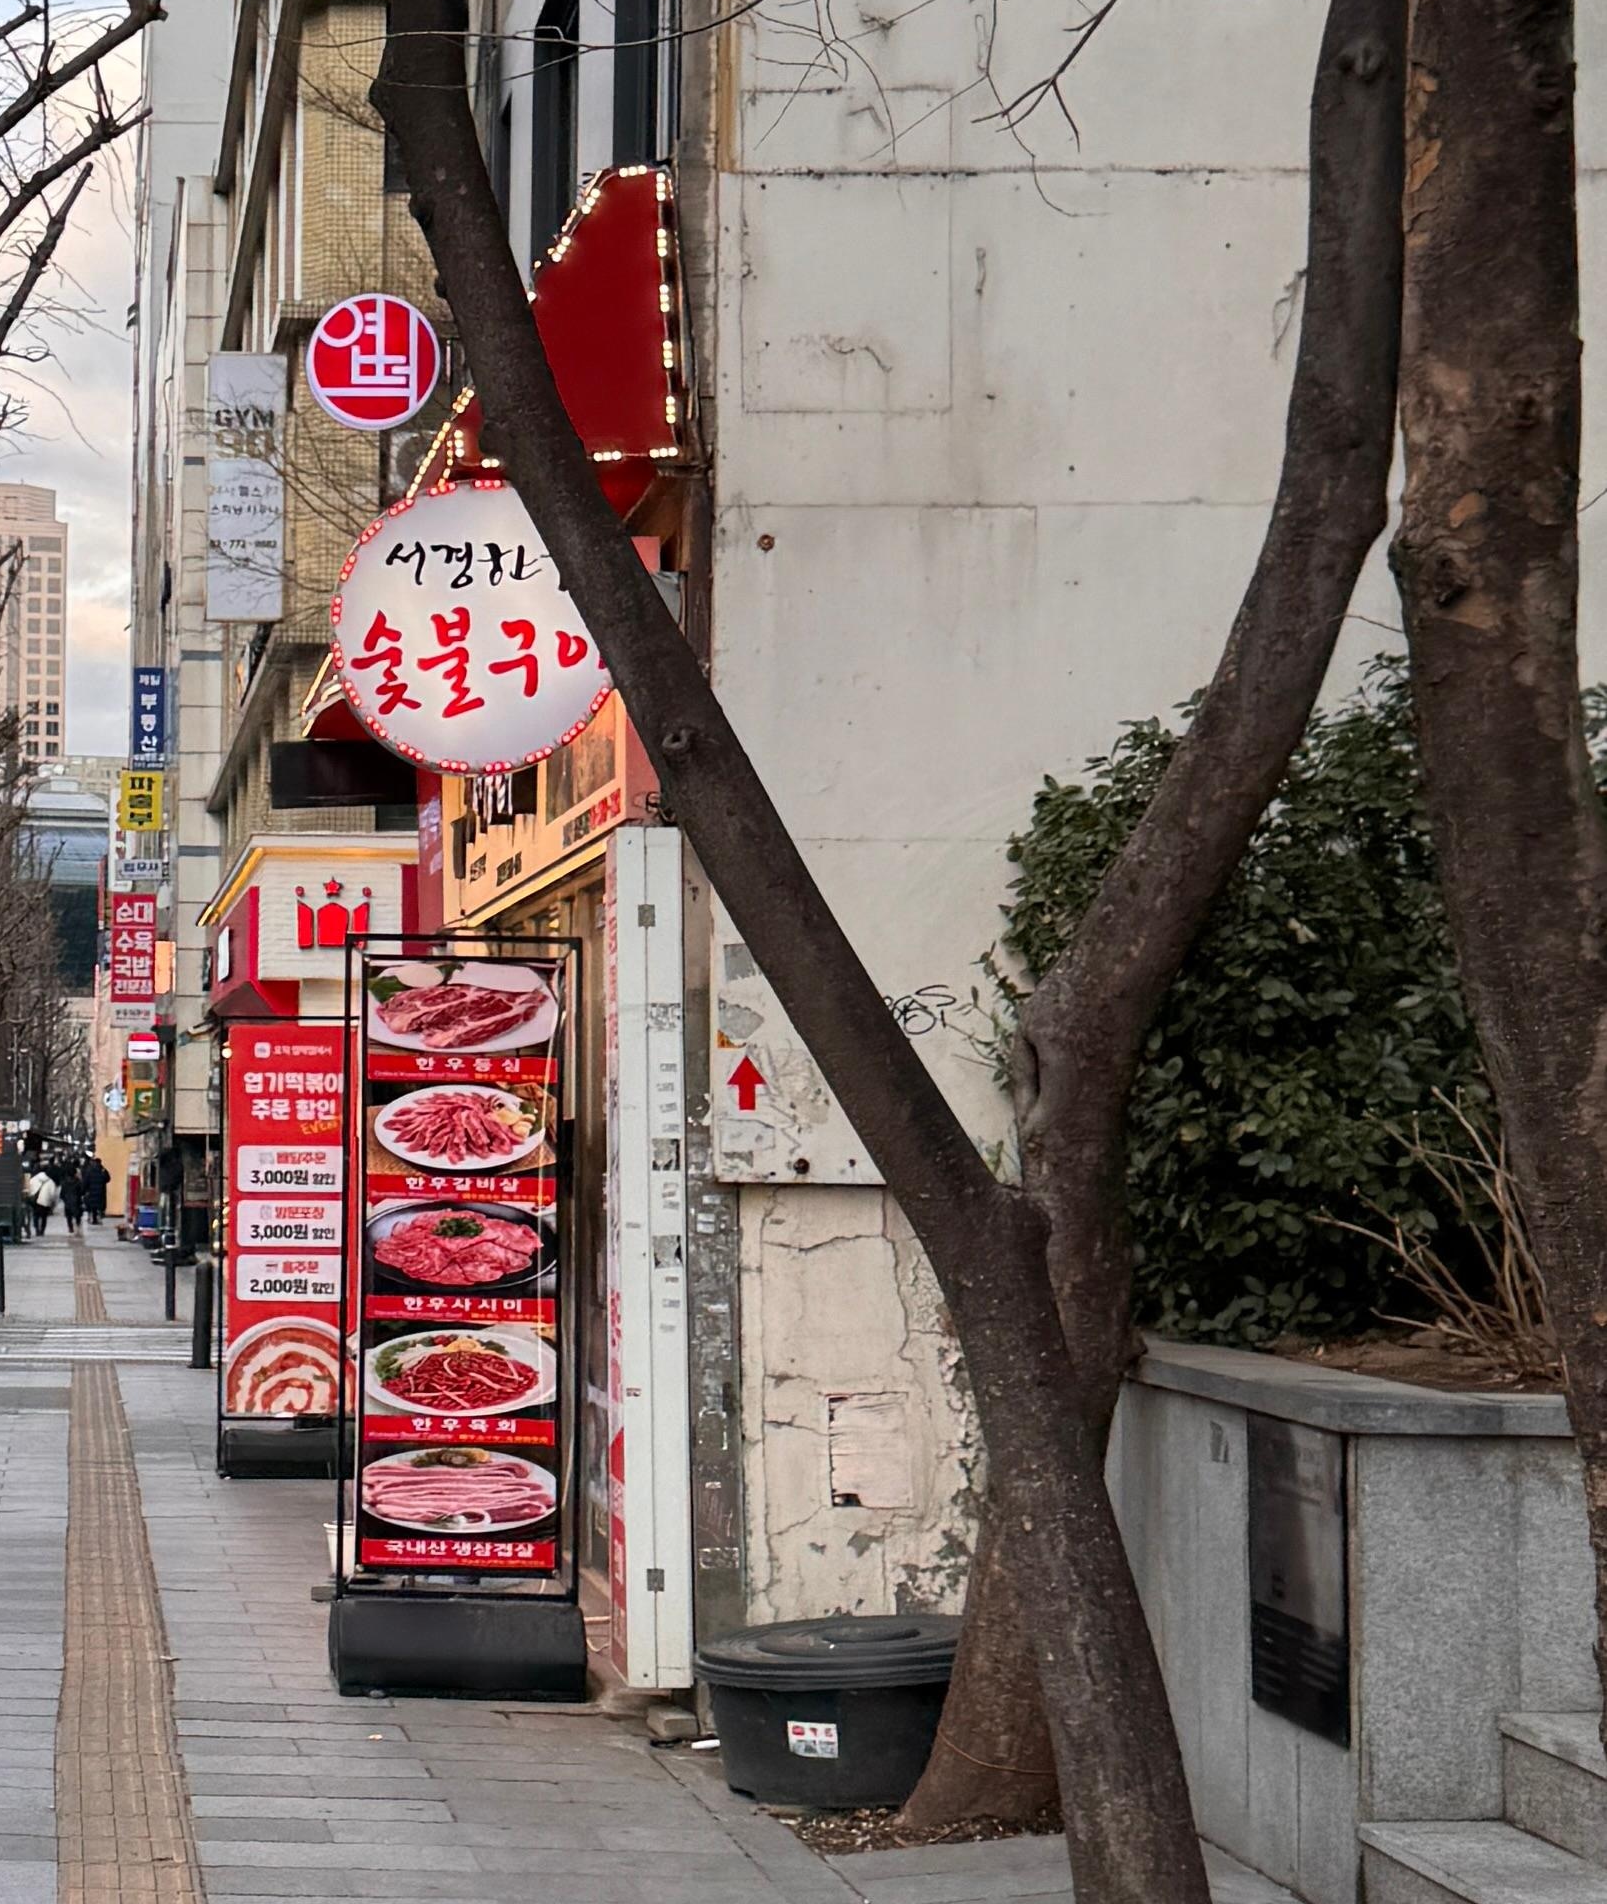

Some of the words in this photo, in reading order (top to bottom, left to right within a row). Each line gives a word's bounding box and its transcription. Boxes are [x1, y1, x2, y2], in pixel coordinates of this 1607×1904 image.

[216, 408, 274, 427] GYM
[385, 541, 551, 589] 서경한
[140, 693, 158, 751] 부동산
[116, 901, 154, 924] 순대
[115, 930, 153, 953] 수육
[114, 955, 153, 978] 국밥
[114, 979, 153, 995] 전문점
[416, 1057, 520, 1073] 한우등심
[243, 1072, 344, 1094] 엽기떡볶이
[251, 1098, 291, 1121] 주문
[295, 1098, 336, 1121] 할인
[250, 1169, 308, 1186] 3,000원
[312, 1173, 335, 1185] 할인
[406, 1177, 520, 1191] 한우갈비살
[250, 1224, 308, 1241] 3,000원
[312, 1228, 335, 1240] 할인
[250, 1279, 307, 1295] 2,000원
[312, 1282, 334, 1294] 할인
[404, 1297, 522, 1312] 한우사시미
[412, 1417, 516, 1432] 한우육회
[384, 1540, 448, 1555] 국내산
[451, 1541, 535, 1558] 생삼겹살
